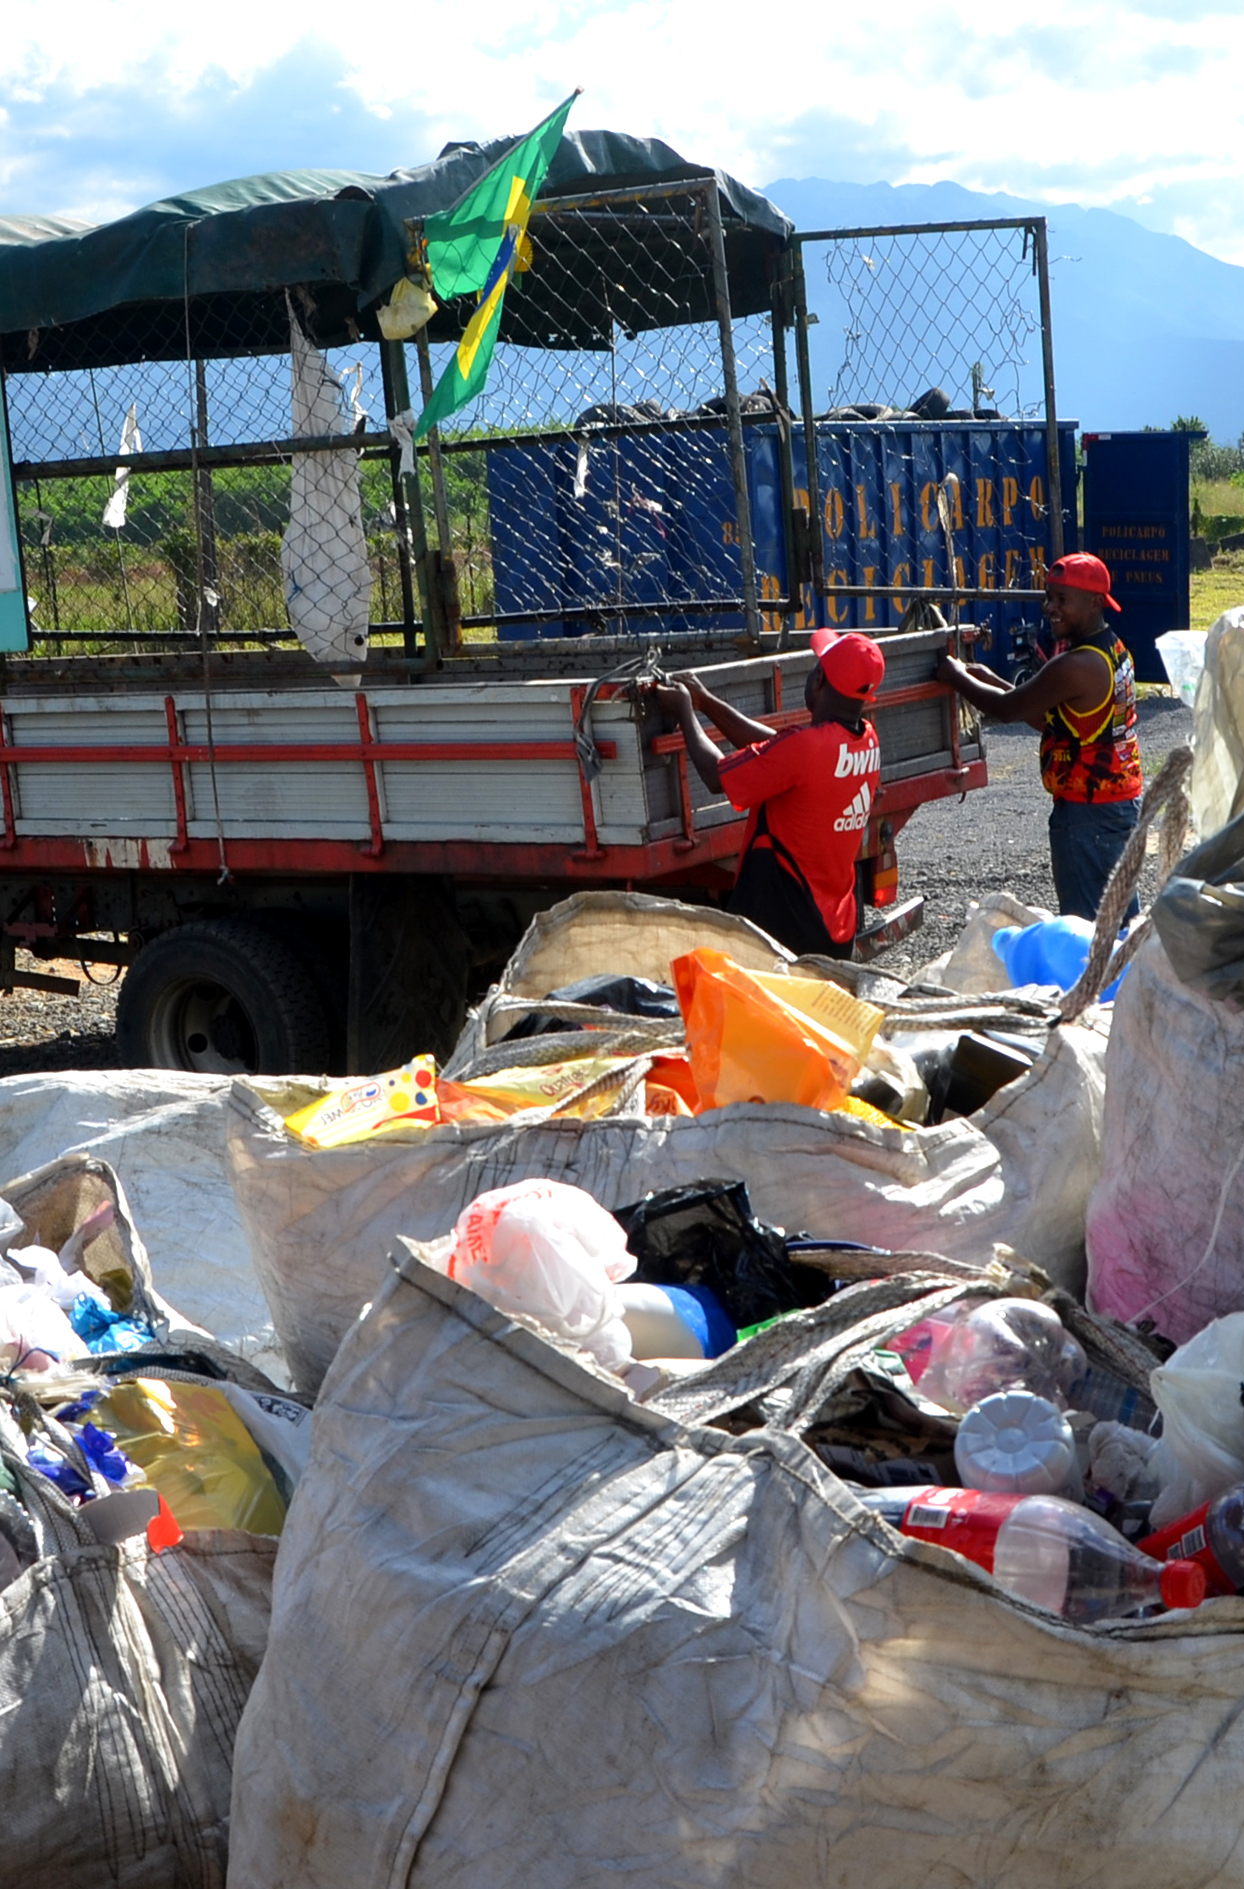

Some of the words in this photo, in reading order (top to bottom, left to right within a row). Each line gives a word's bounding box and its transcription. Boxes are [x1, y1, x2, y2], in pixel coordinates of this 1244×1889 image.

[793, 475, 1045, 540] POLICARPO
[1102, 526, 1166, 538] POLICARPO
[1098, 548, 1169, 562] RECICLAGEM
[1126, 571, 1163, 584] PNEUS
[834, 738, 881, 779] bwin
[833, 811, 871, 832] adid
